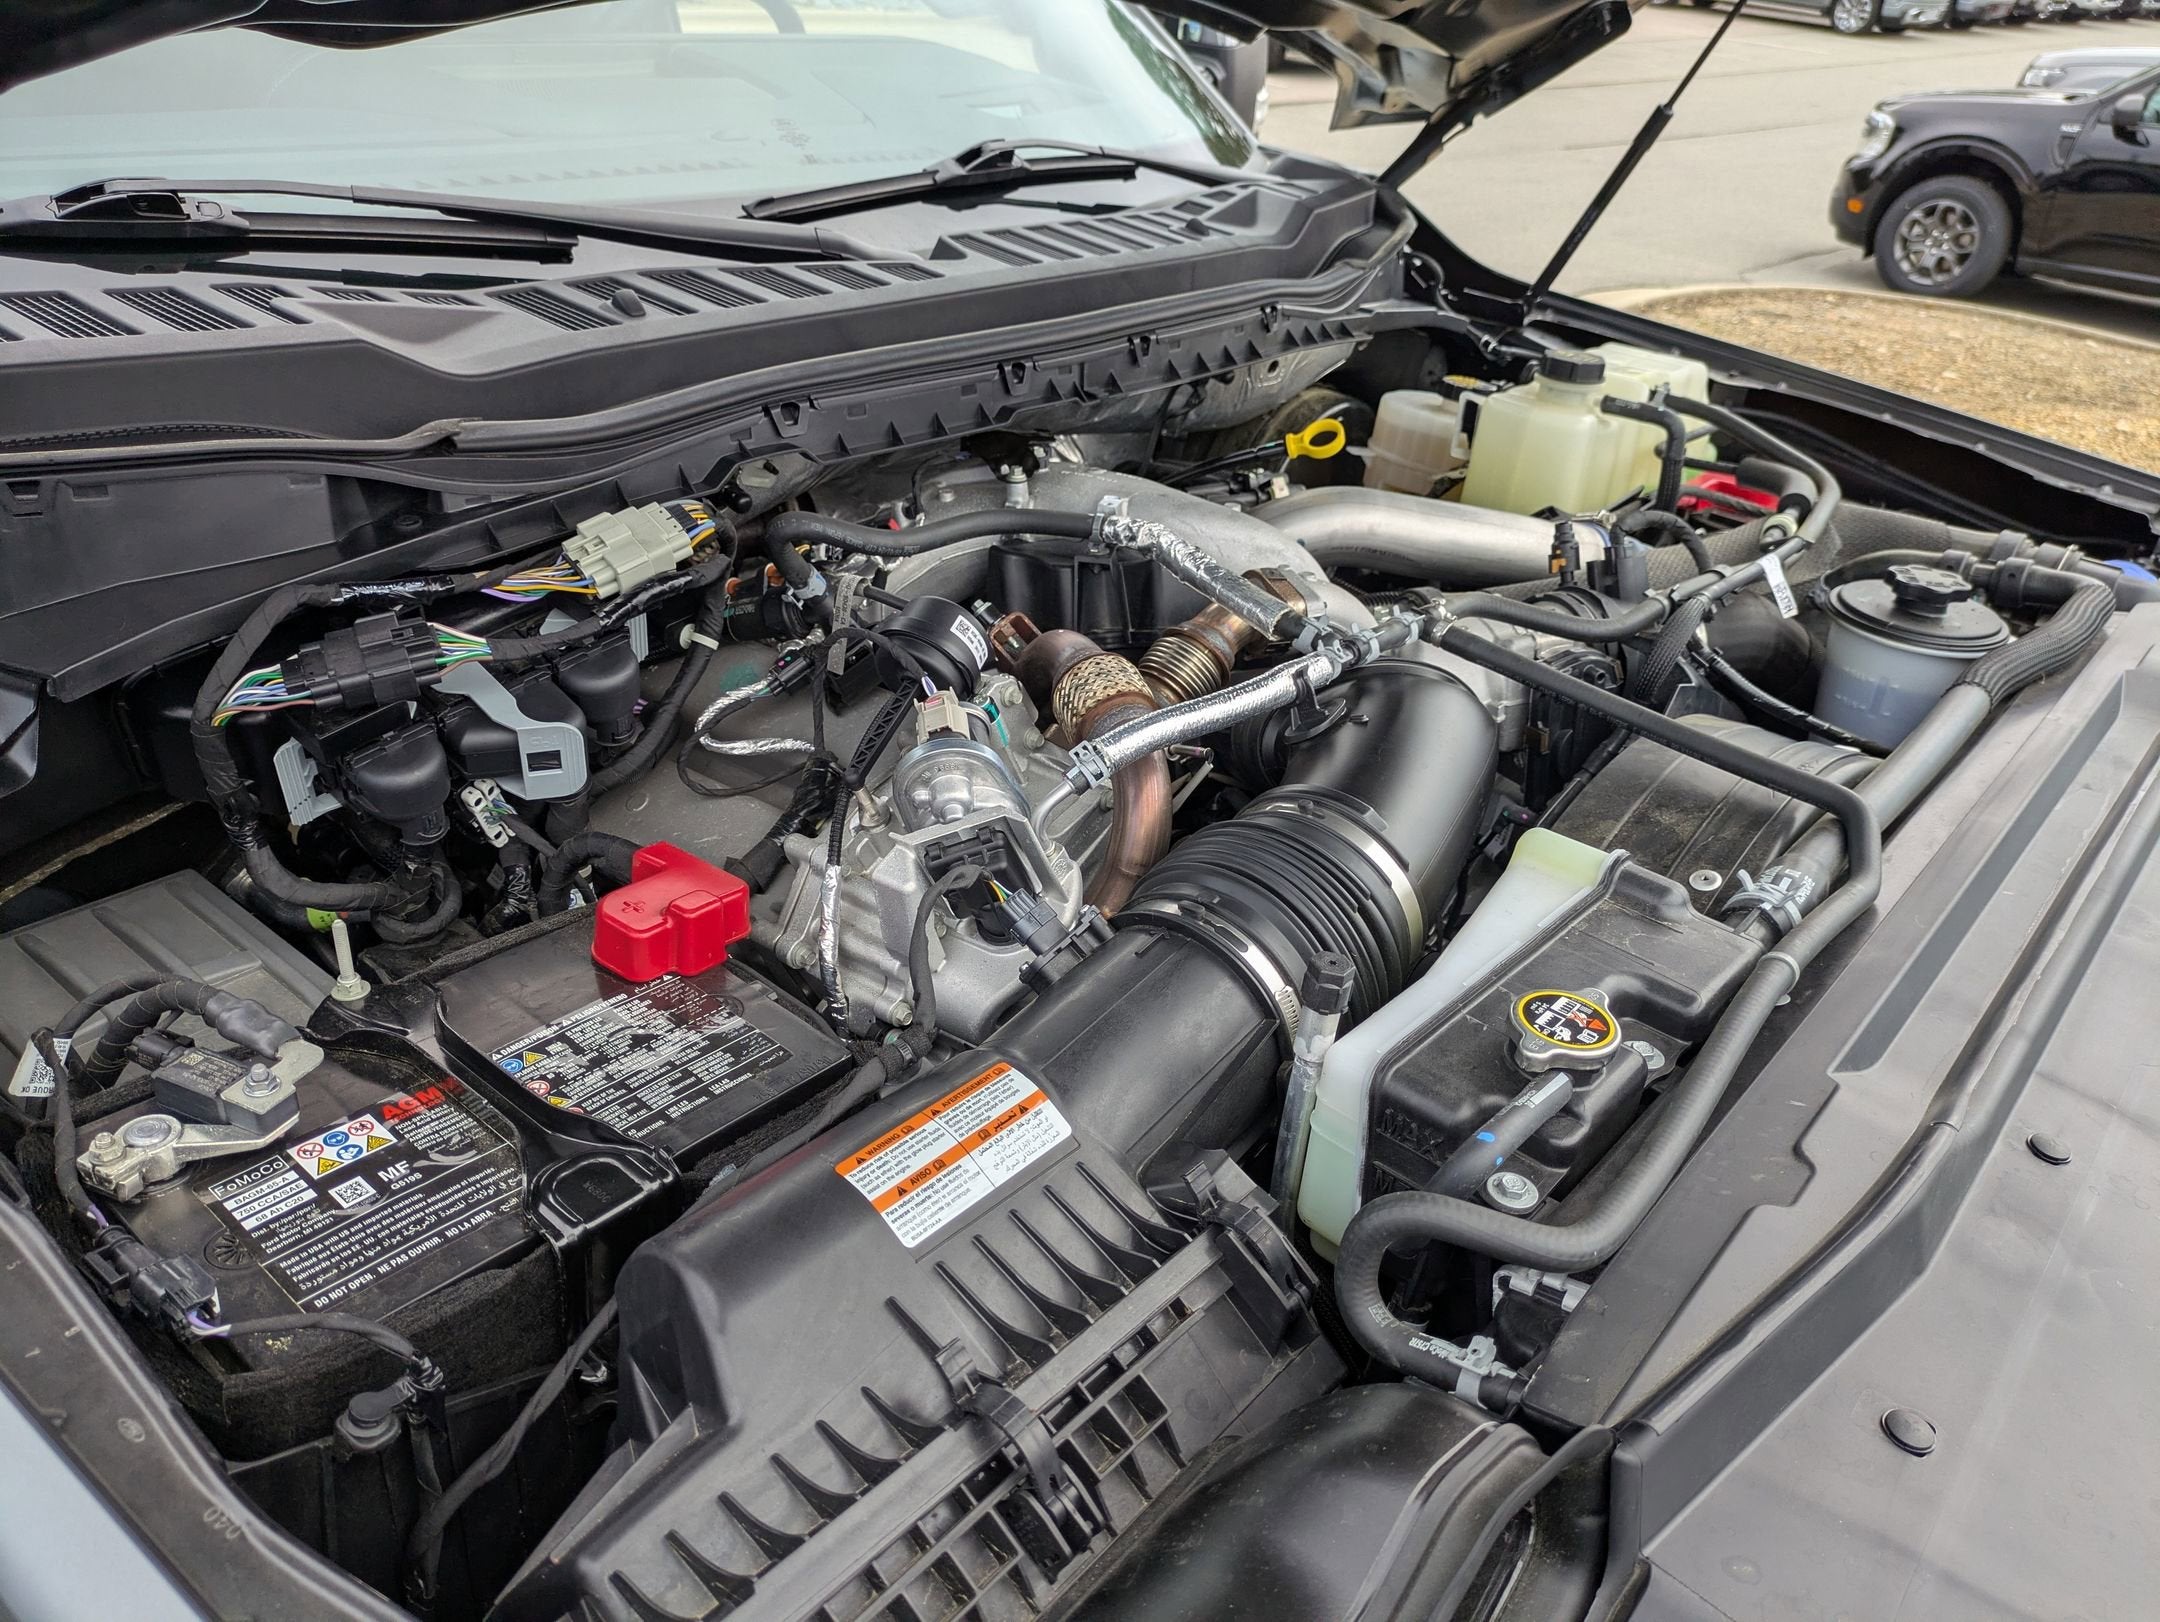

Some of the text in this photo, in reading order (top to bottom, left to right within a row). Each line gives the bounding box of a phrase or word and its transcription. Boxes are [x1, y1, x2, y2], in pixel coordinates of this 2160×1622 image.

[568, 992, 628, 1022] PELIGRO/VENENO
[498, 1025, 561, 1055] DANGER/POISON
[32, 1086, 53, 1094] RQUE
[707, 1083, 720, 1091] LEA
[941, 1072, 993, 1108] AVERTISSEMENT
[382, 1086, 446, 1120] AGM
[664, 1105, 679, 1114] LIRE
[668, 1095, 710, 1118] INSTRUCTIONS.
[394, 1102, 449, 1131] NON-SPILLABLE
[989, 1109, 1018, 1132] تحذير
[855, 1161, 873, 1174] reduce
[872, 1155, 883, 1163] risk
[888, 1138, 909, 1153] possible
[908, 1127, 926, 1140] serious
[864, 1131, 900, 1157] WARNING
[213, 1157, 285, 1197] FoMoCo
[376, 1159, 413, 1182] MF
[908, 1167, 933, 1186] AVISO
[233, 1174, 290, 1205] BAGM-65-A
[465, 1184, 499, 1204] الولايات
[495, 1180, 508, 1189] في
[236, 1181, 304, 1217] 750 CCA/SAE
[254, 1195, 304, 1222] 68 Ah C20
[437, 1199, 468, 1218] المتحدة
[884, 1206, 898, 1217] Para
[260, 1236, 280, 1248] Ford
[278, 1225, 302, 1239] Motor
[278, 1254, 300, 1268] Made
[298, 1250, 309, 1258] in
[307, 1243, 324, 1253] USA
[322, 1234, 340, 1245] with
[337, 1229, 350, 1237] US
[348, 1222, 363, 1232] and
[361, 1207, 394, 1226] imported
[284, 1255, 319, 1275] Fabriqué
[316, 1249, 331, 1259] aux
[328, 1230, 367, 1252] États-Unis
[364, 1223, 382, 1234] avec
[380, 1216, 395, 1225] des
[392, 1200, 427, 1219] matériaux
[301, 1227, 314, 1235] MI
[311, 1216, 335, 1230] 48121
[329, 1254, 341, 1262] en
[339, 1248, 352, 1257] los
[375, 1228, 390, 1238] con
[388, 1211, 425, 1231] materiales
[312, 1207, 496, 1308] DO NOT OPEN. NE PAS OUVRIR. NO LA ABRA.
